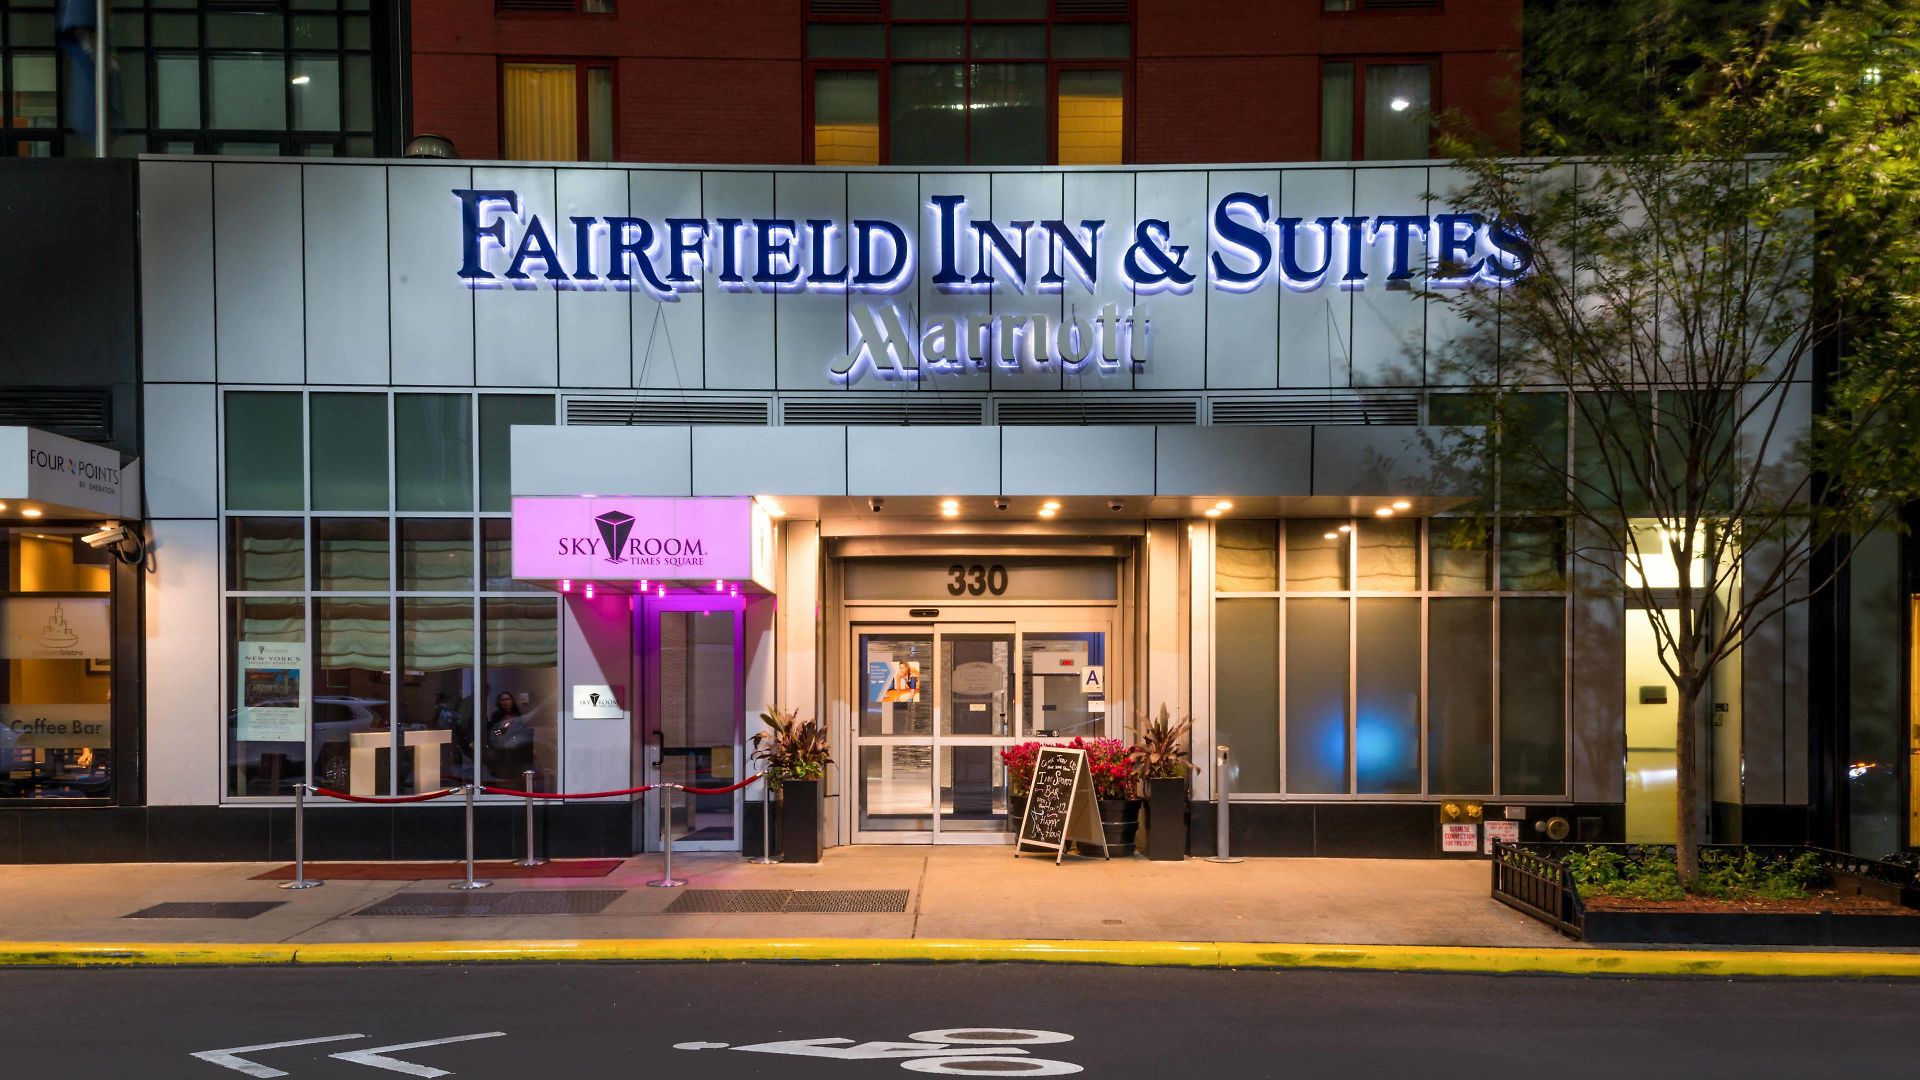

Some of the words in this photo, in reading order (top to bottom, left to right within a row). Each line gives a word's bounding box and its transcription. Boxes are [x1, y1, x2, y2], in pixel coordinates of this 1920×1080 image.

[452, 189, 908, 291] FAIRFIELD
[932, 195, 1105, 286] INN
[1125, 218, 1197, 284] &
[1213, 191, 1534, 284] SUITES
[830, 302, 1151, 374] Marriott
[30, 449, 65, 472] FOUR
[78, 461, 119, 485] POINTS
[88, 483, 116, 495] SHERATON
[558, 537, 600, 556] SKY
[630, 538, 703, 556] ROOM
[630, 557, 661, 566] TIMES
[664, 557, 704, 567] SQUARE
[947, 564, 1009, 596] 330
[1086, 670, 1099, 686] A
[10, 718, 67, 735] Coffee
[72, 720, 103, 735] Bar
